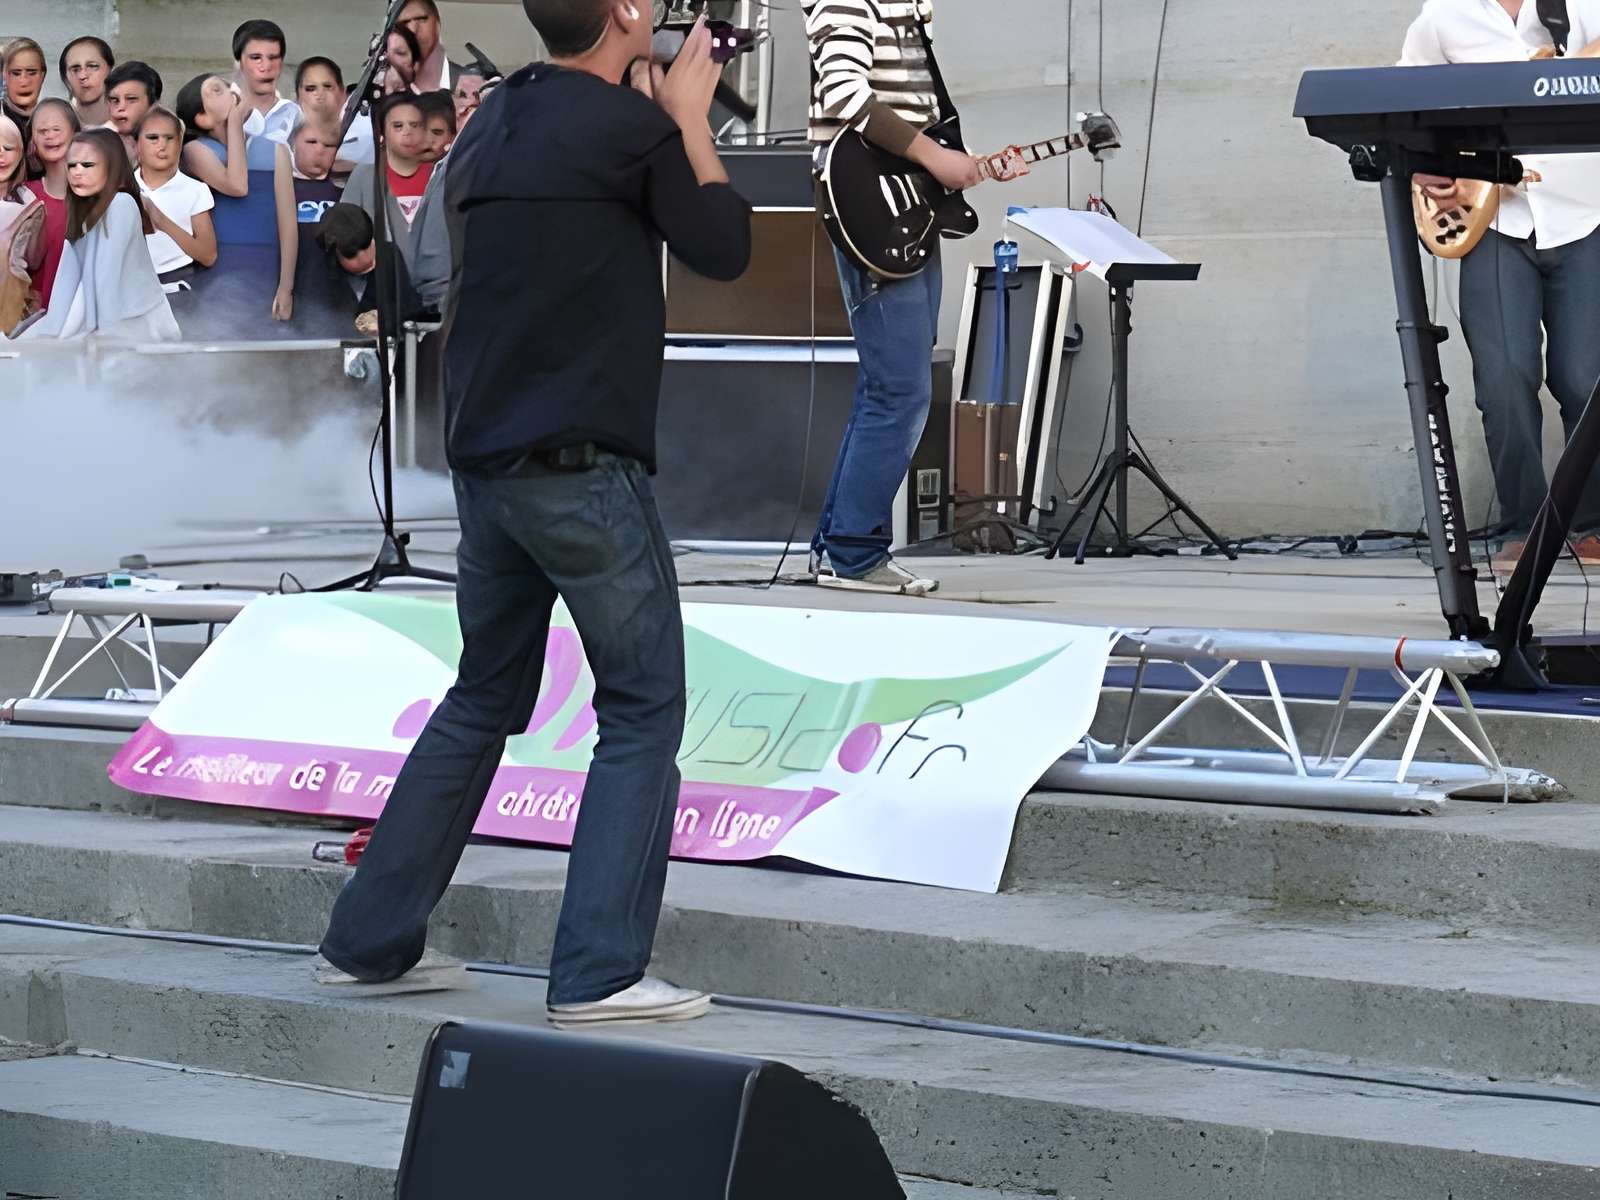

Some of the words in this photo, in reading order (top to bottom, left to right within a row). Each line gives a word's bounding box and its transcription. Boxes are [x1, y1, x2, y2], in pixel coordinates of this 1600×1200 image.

[132, 746, 173, 777] Le
[289, 758, 327, 791] de
[333, 761, 362, 793] la
[709, 800, 782, 848] ligne
